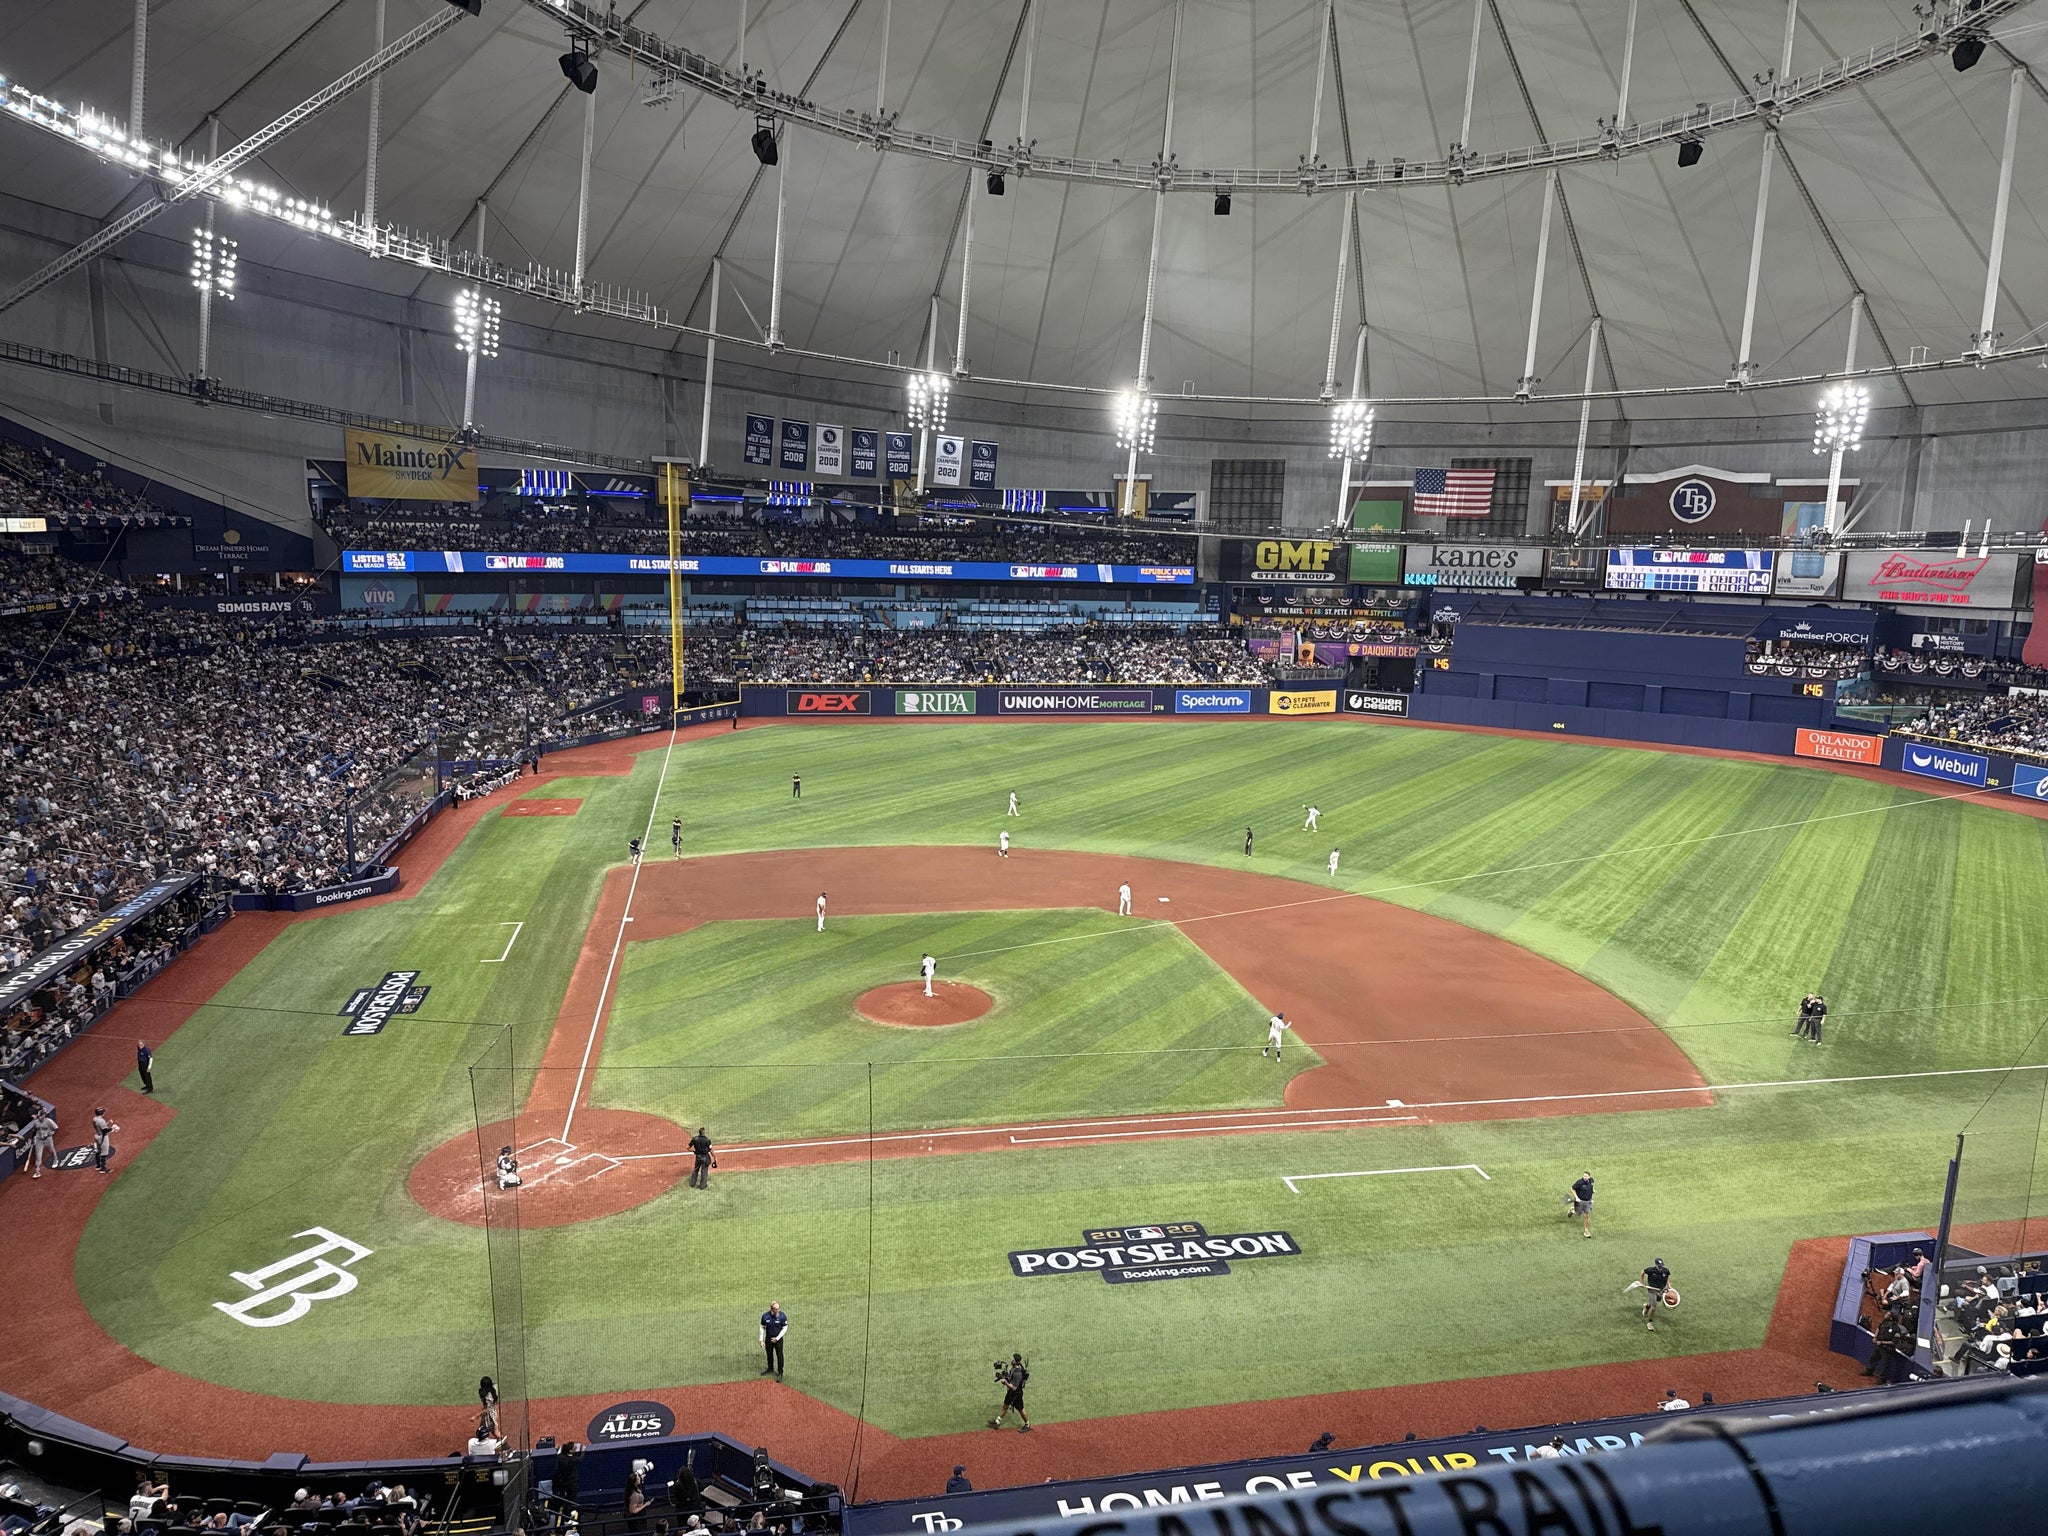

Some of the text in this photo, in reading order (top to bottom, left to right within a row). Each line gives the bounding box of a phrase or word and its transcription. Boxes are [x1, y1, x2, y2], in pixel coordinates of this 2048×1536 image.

[356, 442, 466, 480] MaintenX
[784, 452, 804, 462] 2008
[820, 456, 839, 466] 2008
[856, 460, 872, 470] 2010
[890, 463, 908, 472] 2020
[396, 470, 432, 480] SKYDECK
[938, 467, 957, 478] 2020
[974, 471, 992, 481] 2021
[386, 554, 404, 562] 95.7
[508, 556, 564, 568] PLAYBALL.ORG
[1256, 542, 1333, 570] GMF
[1428, 545, 1518, 568] kane's
[1672, 552, 1724, 564] PLAYBALL.ORG
[630, 560, 698, 570] IT ALL STARS HERE
[780, 561, 830, 573] PLAYBALL.ORG
[890, 565, 952, 575] IT ALL STARTS HERE
[1881, 561, 1976, 579] Budweiser
[1029, 566, 1078, 578] PLAYBALL.ORG
[1258, 572, 1290, 580] STEEL
[1749, 573, 1769, 585] 0-0
[1878, 592, 1972, 604] THIS BUD'S FOR YOU.
[218, 603, 261, 612] SOMOS
[262, 602, 292, 612] RAYS
[1433, 614, 1460, 622] PORCH
[1780, 630, 1868, 644] Budweiser PORCH
[1362, 646, 1396, 656] DAIQUIRI
[798, 694, 860, 711] DEX
[921, 693, 968, 712] RIPA
[1182, 694, 1239, 708] Spectrum
[1293, 701, 1330, 709] CLEARWATER
[1809, 733, 1870, 748] ORLANDO
[1815, 746, 1862, 760] HEALTH
[1934, 758, 1978, 777] Webull
[1987, 778, 1998, 786] 382
[316, 886, 372, 904] Booking.com
[78, 918, 123, 937] BACK
[61, 937, 93, 949] TO
[350, 972, 416, 1034] POSTSEASON
[1090, 1224, 1198, 1240] 20 26
[1016, 1231, 1292, 1273] POSTSEASON
[212, 1226, 374, 1328] TB
[1122, 1264, 1211, 1280] Booking.com
[600, 1418, 662, 1434] ALDS
[610, 1431, 660, 1440] Booking.com
[1056, 1481, 1226, 1518] HOME
[1244, 1471, 1318, 1497] OF
[1328, 1452, 1478, 1483] YOUR
[1439, 1460, 1665, 1536] RAIL
